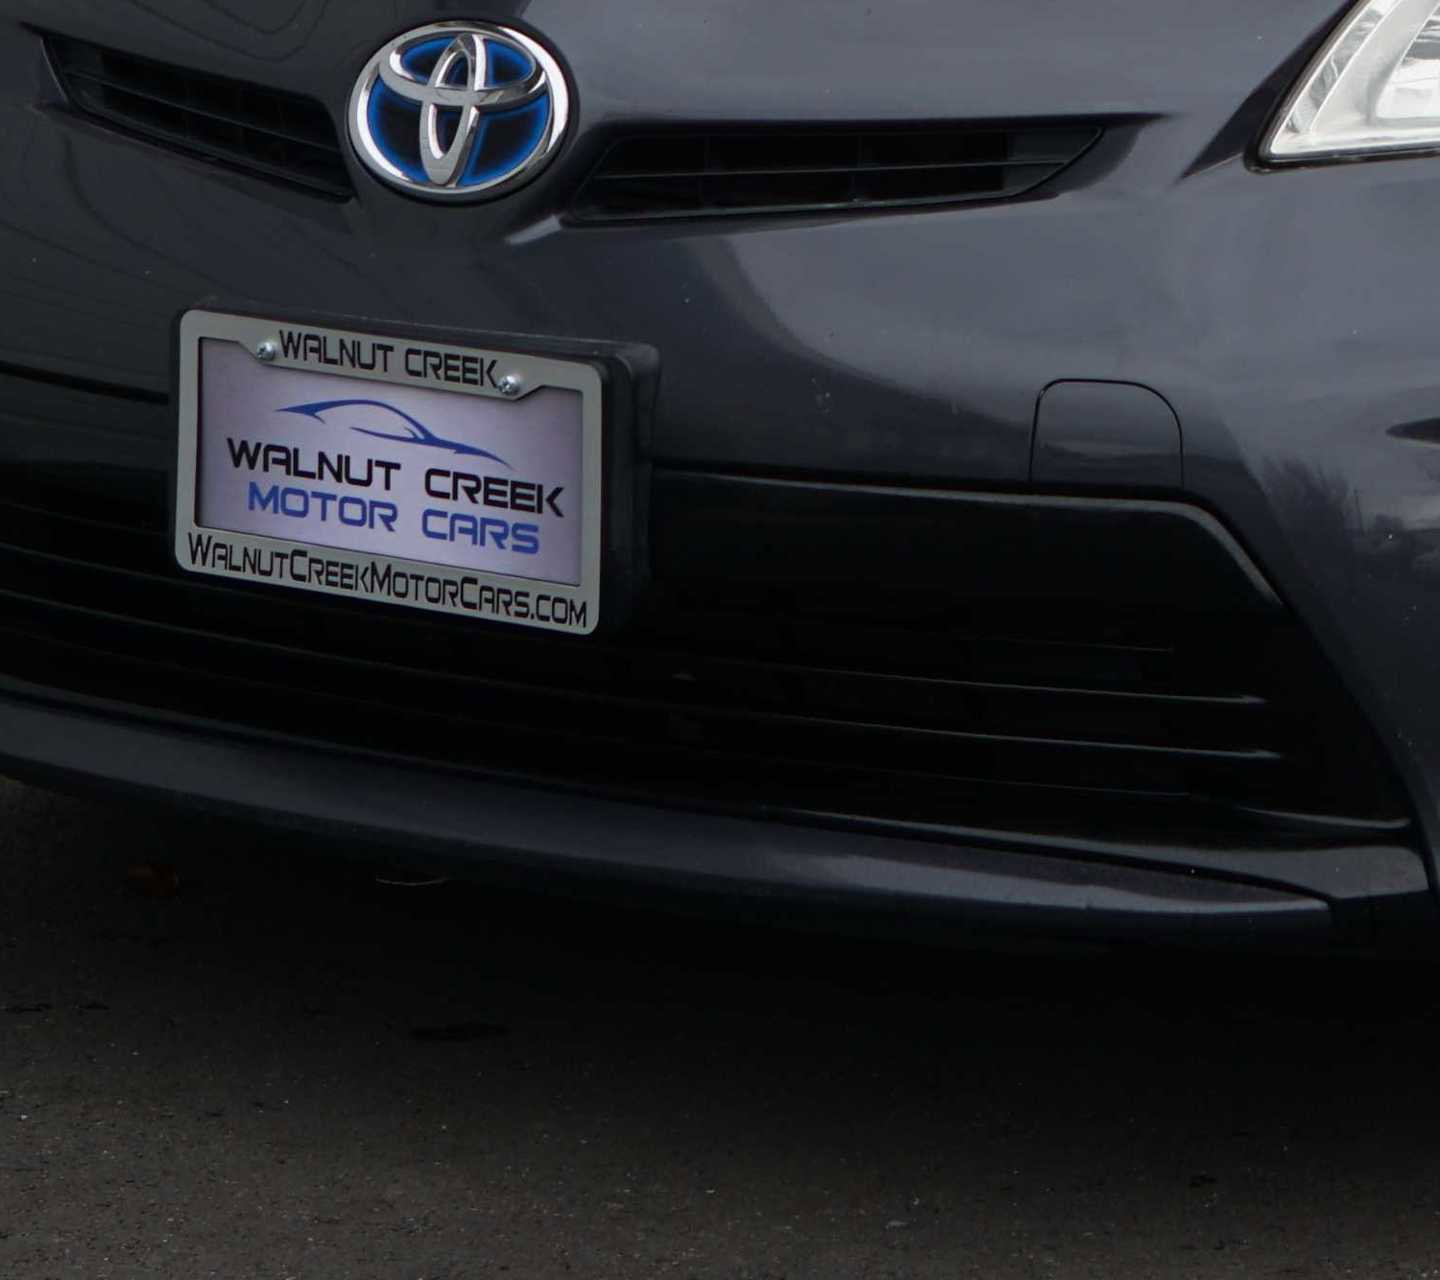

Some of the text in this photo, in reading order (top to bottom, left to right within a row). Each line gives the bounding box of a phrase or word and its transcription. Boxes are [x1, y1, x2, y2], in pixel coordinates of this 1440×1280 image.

[277, 329, 498, 389] WALNUT CREEK
[227, 437, 565, 519] WALNUT CREEK
[247, 480, 540, 555] MOTOR CARS
